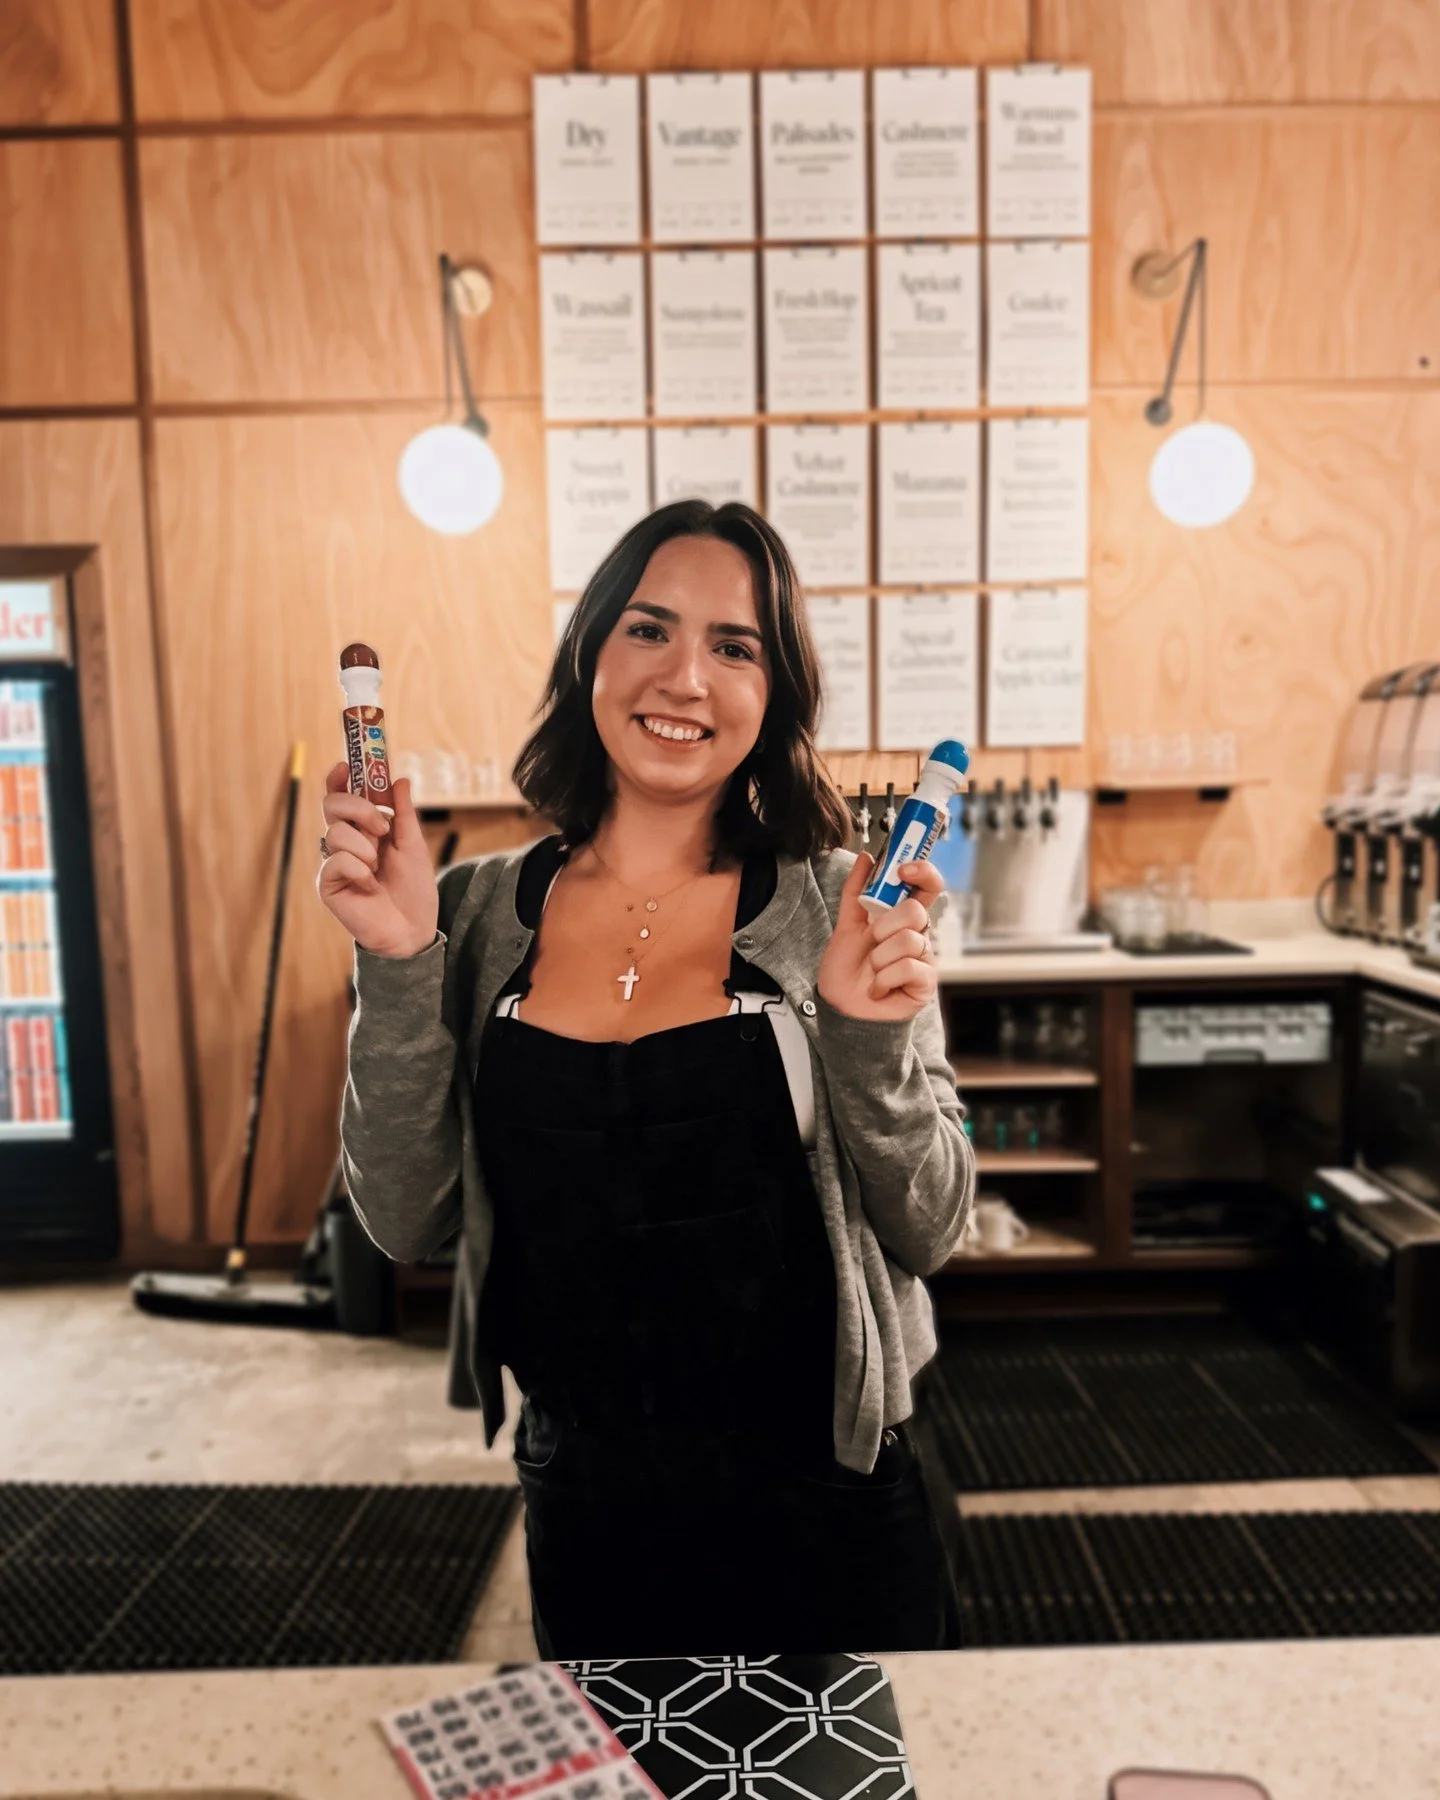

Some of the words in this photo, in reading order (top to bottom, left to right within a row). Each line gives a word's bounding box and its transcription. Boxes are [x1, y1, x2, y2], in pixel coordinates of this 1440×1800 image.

[565, 121, 606, 154] Dry
[658, 121, 741, 151] Vantage
[771, 120, 854, 144] Palisades
